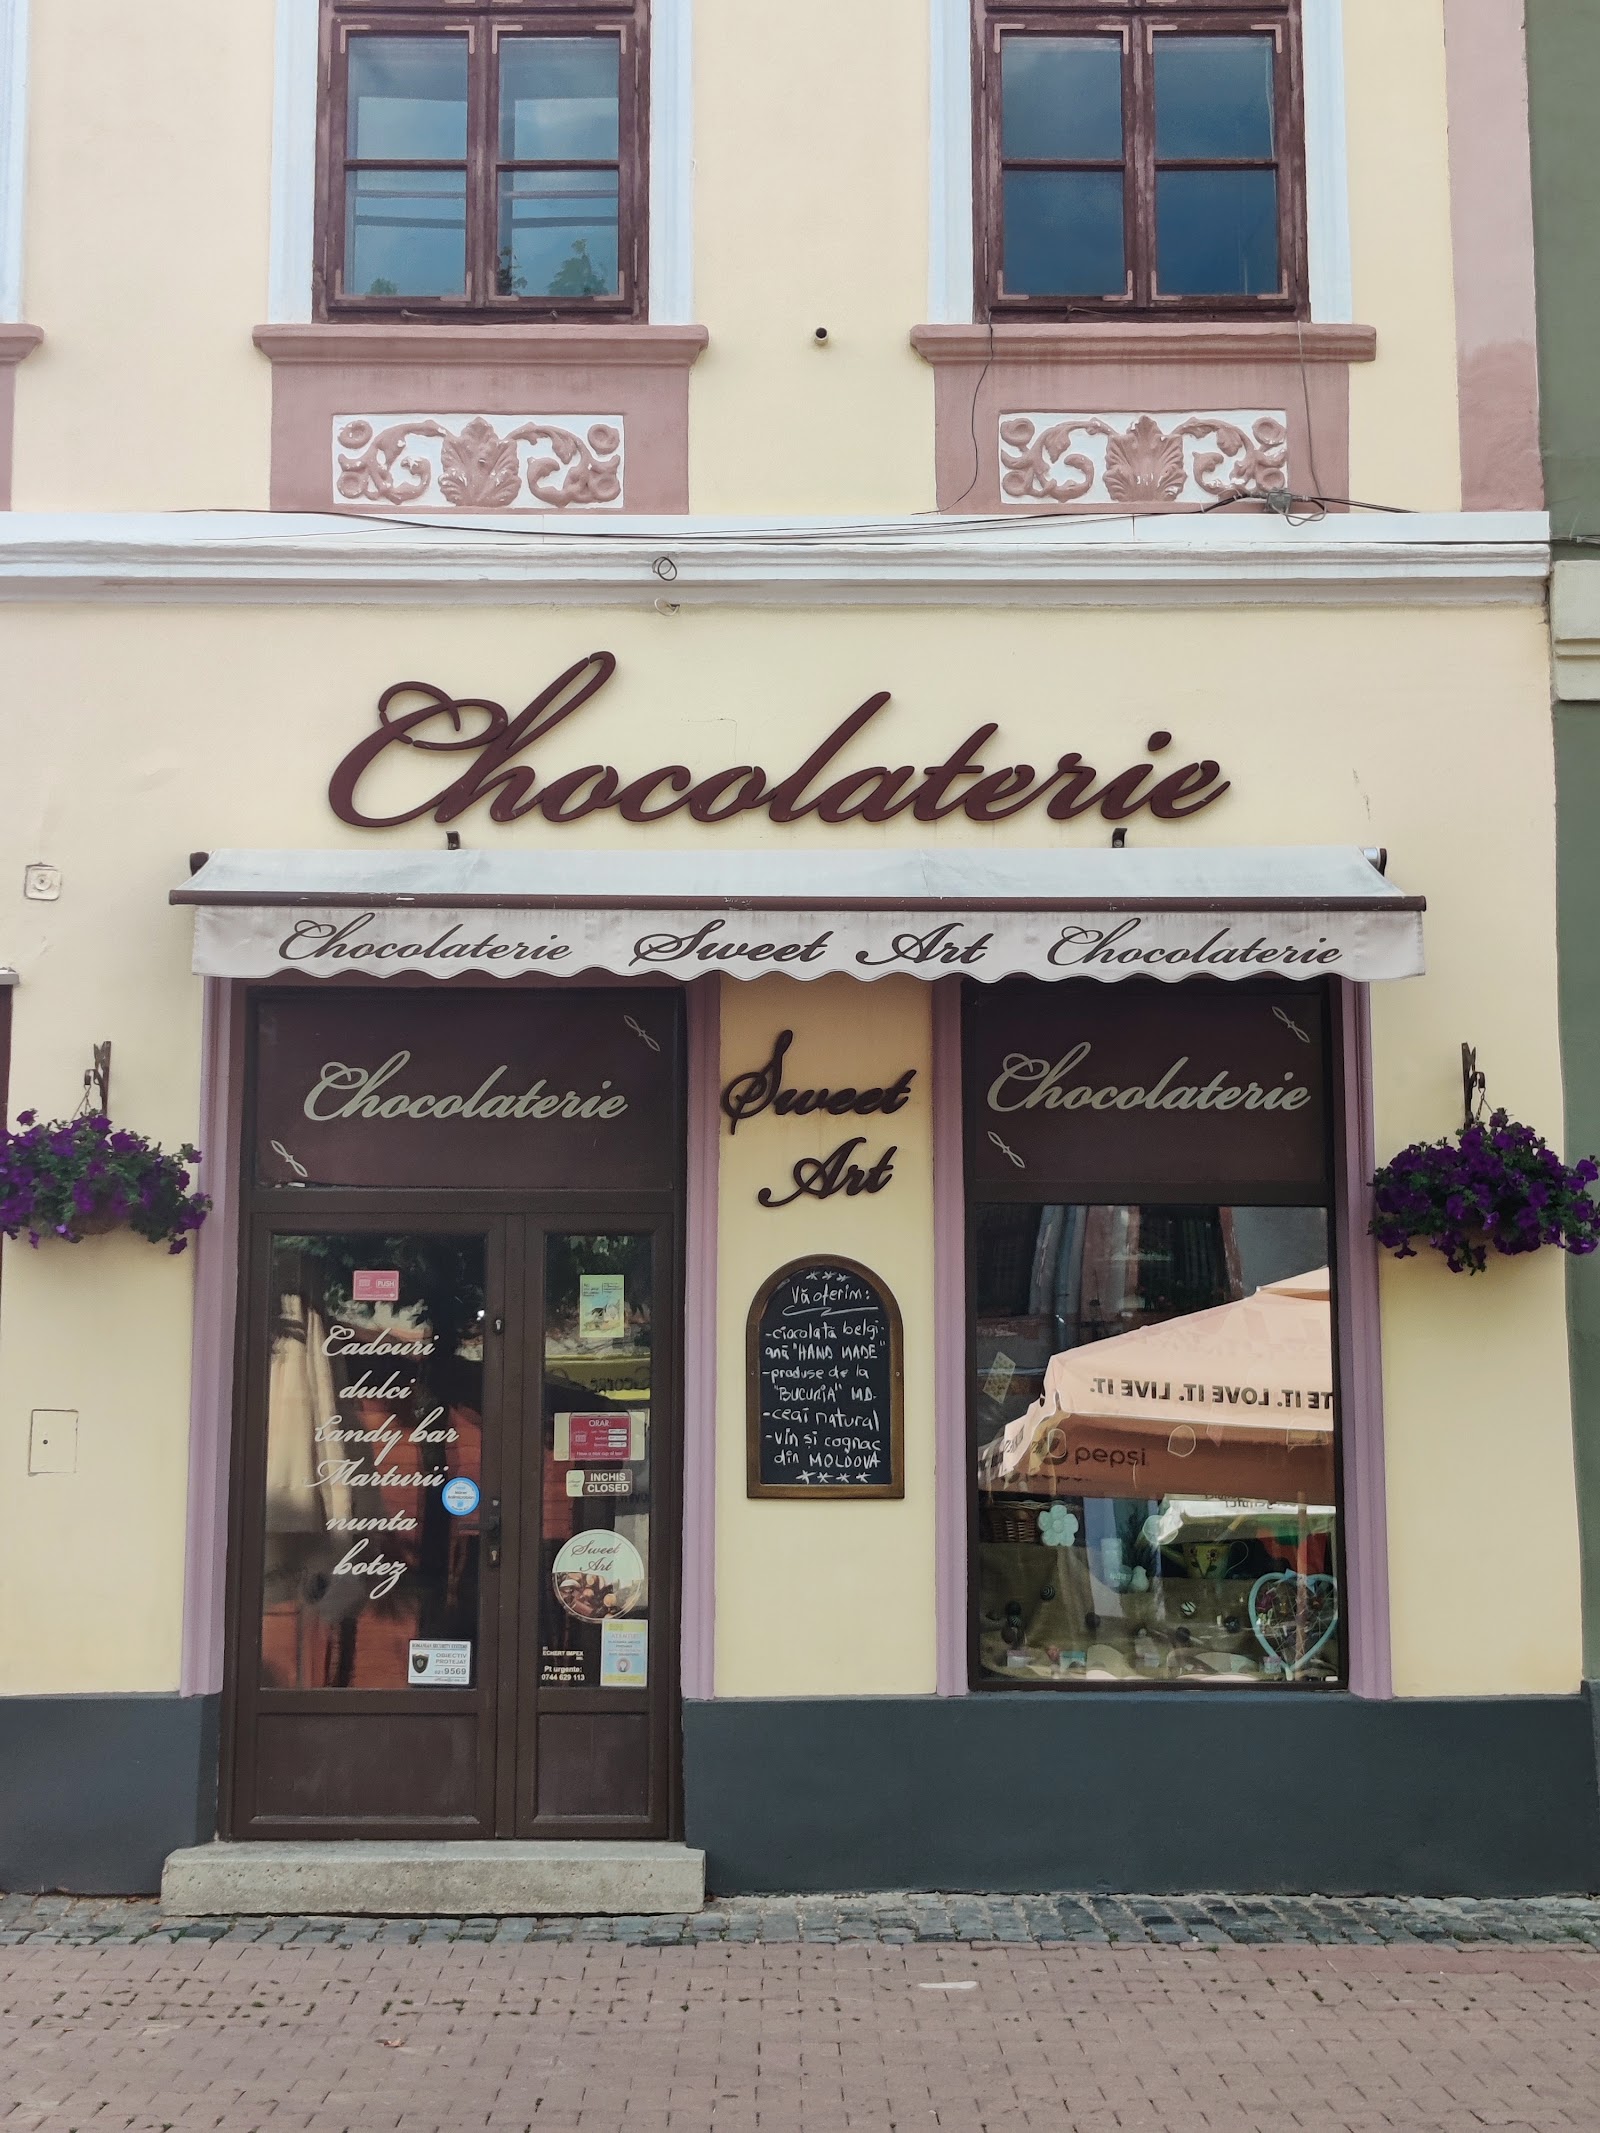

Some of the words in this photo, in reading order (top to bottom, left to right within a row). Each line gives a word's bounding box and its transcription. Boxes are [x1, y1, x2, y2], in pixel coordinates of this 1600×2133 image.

[328, 651, 1231, 826] Chocolaterie
[279, 912, 573, 960] Chocolaterie
[628, 919, 834, 966] Sweet
[856, 922, 994, 965] Art
[1047, 917, 1343, 966] Chocolaterie
[303, 1050, 628, 1122] Chocolaterie
[723, 1029, 917, 1135] Sweet
[986, 1041, 1312, 1112] Chocolaterie
[757, 1137, 898, 1208] Art
[321, 1325, 440, 1356] Cadouri
[339, 1369, 417, 1399] dulci
[828, 1366, 848, 1378] de
[856, 1364, 869, 1379] la
[408, 1407, 459, 1442] bar
[816, 1408, 880, 1432] natural
[824, 1435, 882, 1453] cognac
[1075, 1446, 1147, 1468] pepsi
[305, 1457, 449, 1486] Marturii
[774, 1451, 799, 1465] din
[809, 1451, 881, 1469] MOLDOVA
[587, 1483, 629, 1493] CLOSED
[590, 1472, 626, 1482] INCHIS
[326, 1510, 418, 1531] nunta
[571, 1539, 622, 1556] Sweet
[333, 1538, 408, 1599] botez
[579, 1556, 614, 1572] Art
